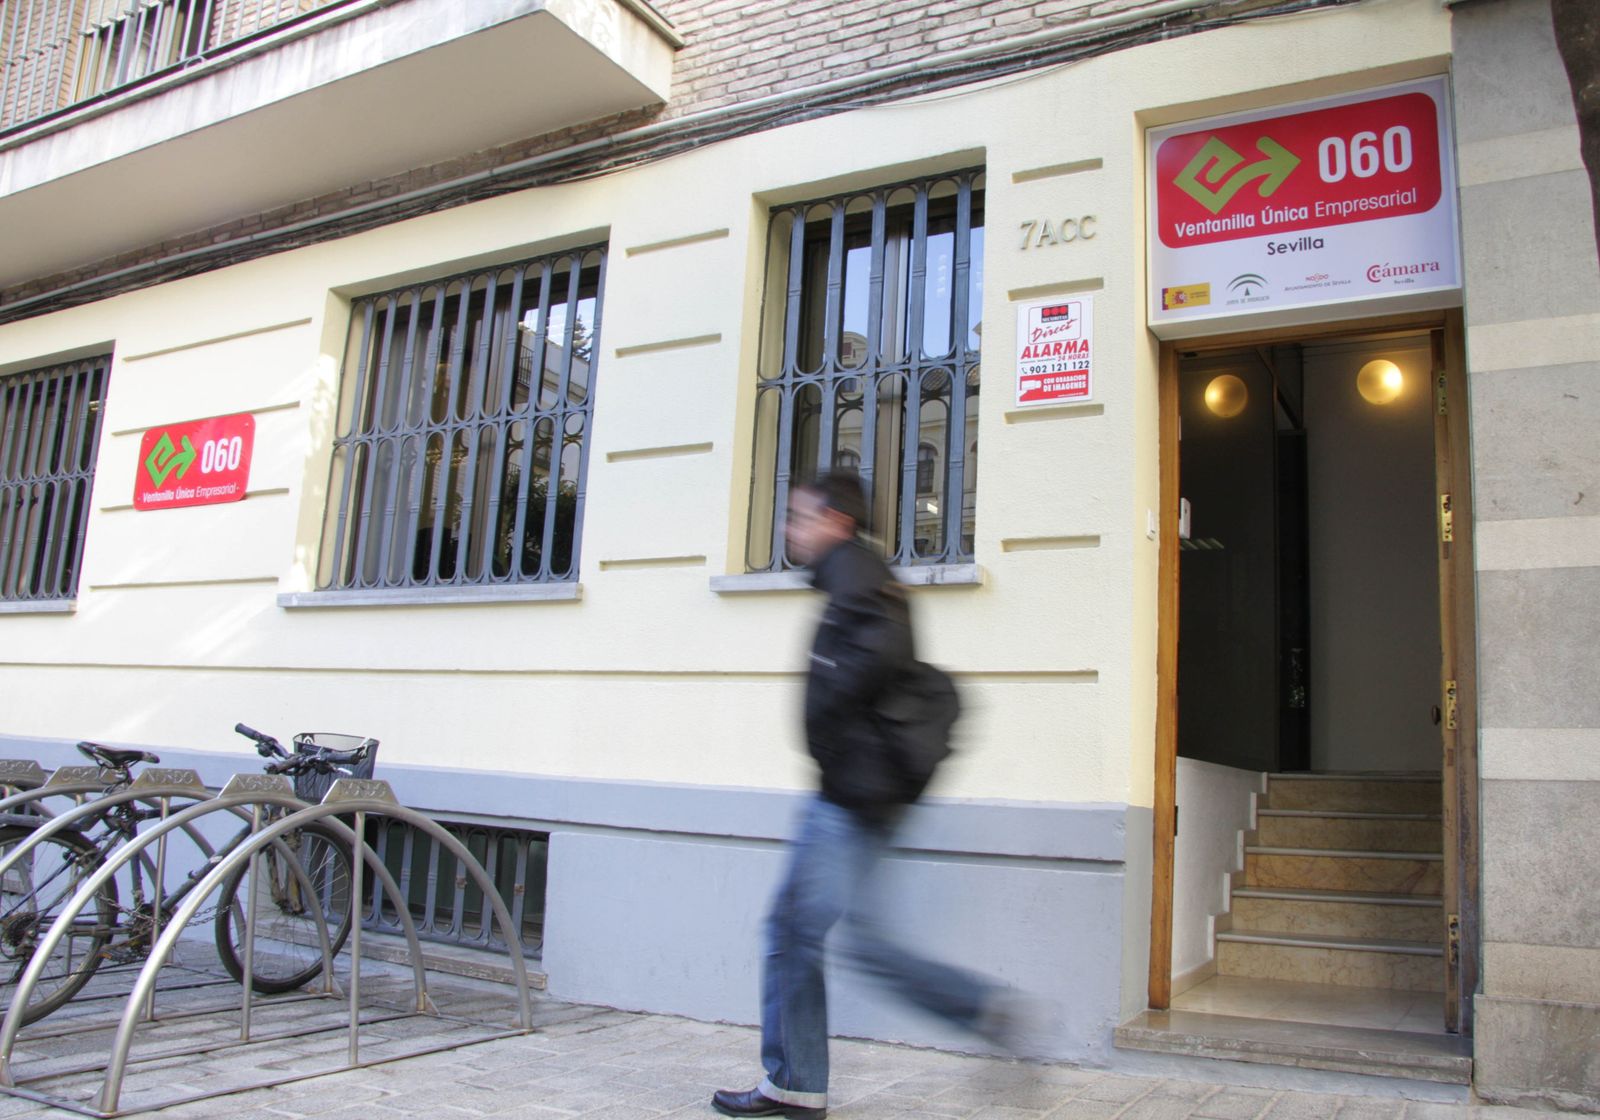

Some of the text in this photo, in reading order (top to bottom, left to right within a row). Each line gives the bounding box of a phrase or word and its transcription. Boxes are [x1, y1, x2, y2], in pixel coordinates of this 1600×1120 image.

[1318, 125, 1413, 183] 060
[1174, 188, 1417, 238] Ventanilla Única Empresarial
[1267, 237, 1324, 256] Sevilla
[1031, 319, 1078, 342] Direct
[1021, 339, 1089, 360] ALARMA
[1029, 360, 1090, 374] 902 121 122
[1043, 381, 1087, 392] DE IMAGENES
[201, 436, 242, 474] 060
[143, 482, 237, 503] Ventanilla Única Empresarial
